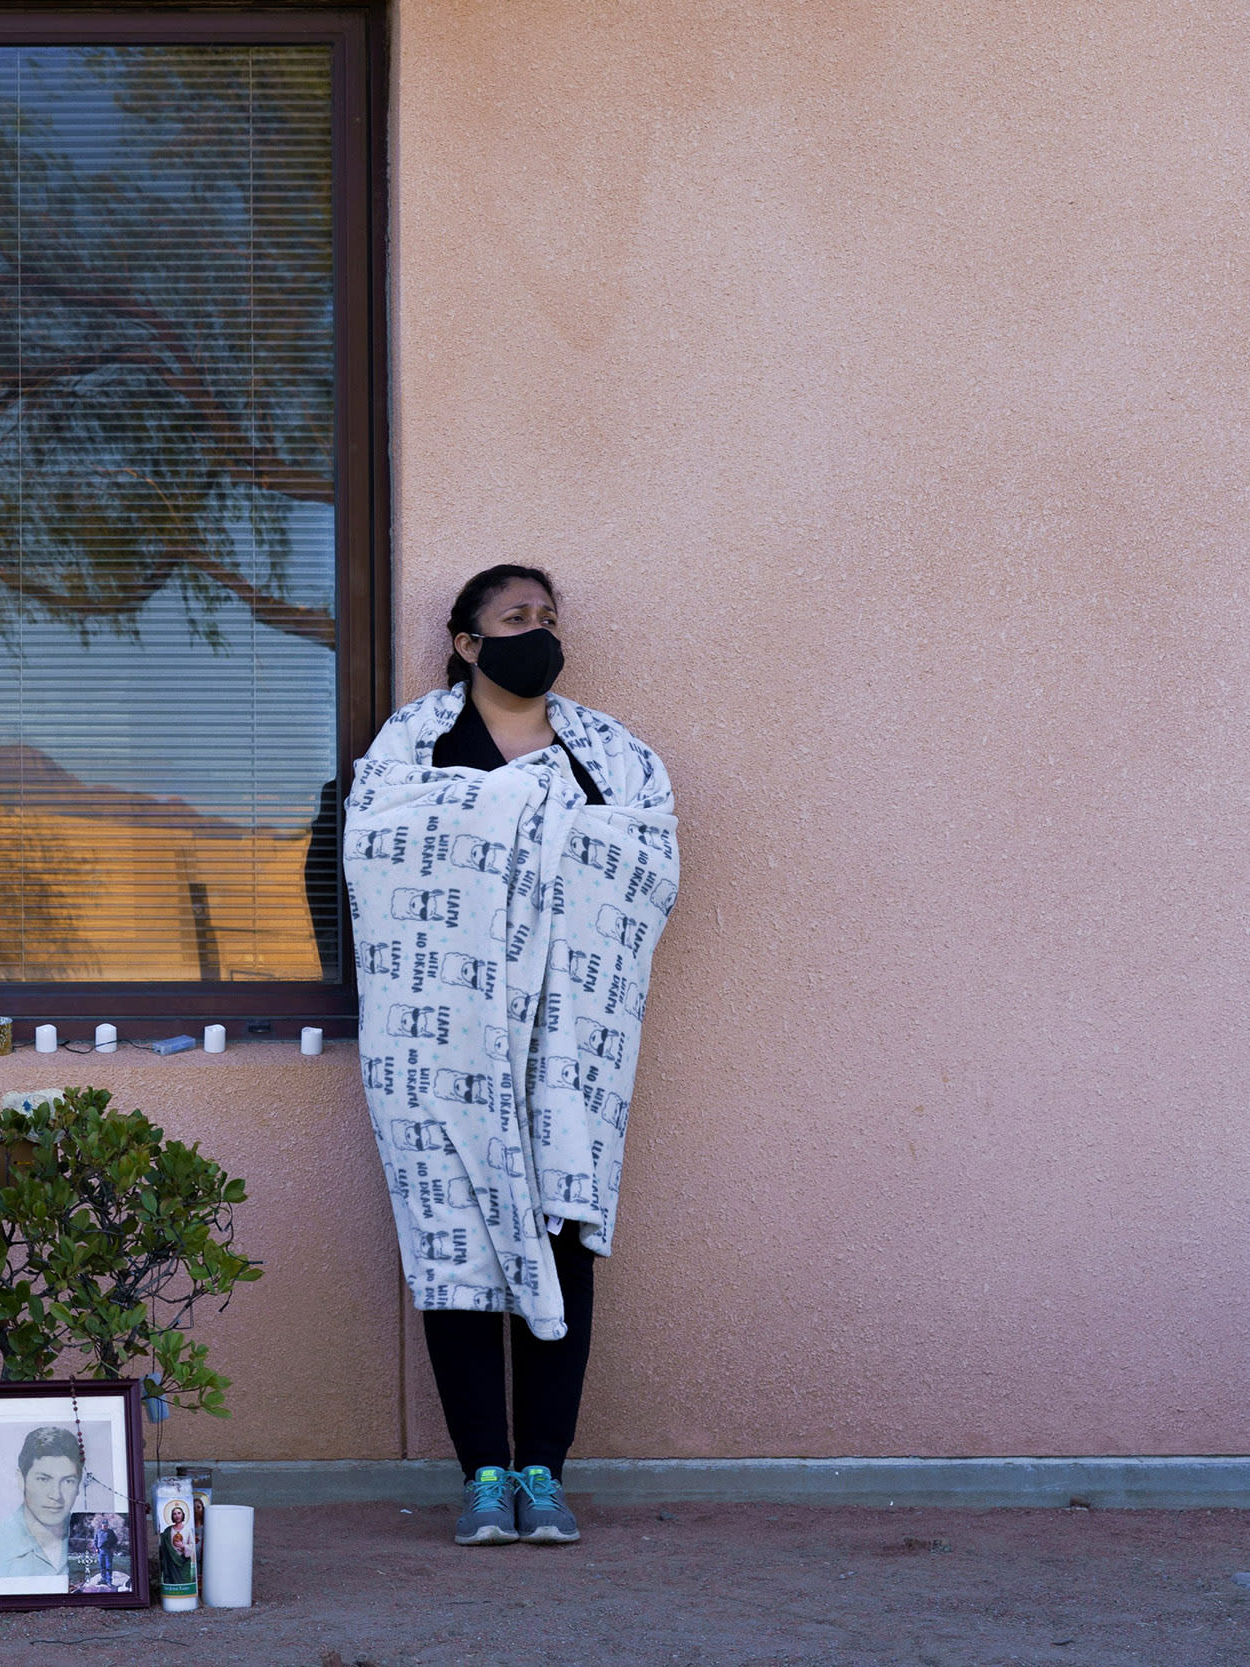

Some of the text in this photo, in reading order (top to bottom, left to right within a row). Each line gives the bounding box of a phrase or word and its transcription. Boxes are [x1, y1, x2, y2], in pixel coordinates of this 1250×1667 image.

[391, 826, 409, 864] LLAMA
[420, 816, 438, 876] NO DRAMA
[437, 835, 449, 860] WITH
[517, 849, 530, 864] NO
[605, 844, 621, 880] LLAMA
[518, 871, 535, 896] WITH
[552, 876, 564, 914] LLAMA
[625, 850, 648, 902] NO DRAMA
[641, 872, 656, 894] WITH
[445, 889, 460, 928] LLAMA
[391, 941, 401, 980] LLAMA
[507, 924, 530, 962] LLAMA
[411, 932, 427, 993] NO DRAMA
[427, 952, 438, 978] WITH
[485, 961, 498, 1000] LLAMA
[583, 954, 601, 992] LLAMA
[605, 955, 622, 1014] NO DRAMA
[437, 1006, 450, 1045] LLAMA
[548, 993, 562, 1033] LLAMA
[529, 1038, 539, 1053] NO
[614, 1032, 625, 1070] LLAMA
[384, 1056, 394, 1095] LLAMA
[406, 1049, 419, 1108] NO DRAMA
[419, 1068, 430, 1094] WITH
[586, 1066, 598, 1082] NO
[500, 1073, 512, 1132] NO DRAMA
[590, 1088, 605, 1114] WITH
[542, 1109, 551, 1146] LLAMA
[417, 1162, 433, 1218] NO DRAMA
[432, 1180, 444, 1204] WITH
[486, 1188, 500, 1226] LLAMA
[453, 1229, 466, 1264] LLAMA
[426, 1269, 434, 1281] NO
[528, 1260, 539, 1296] LLAMA
